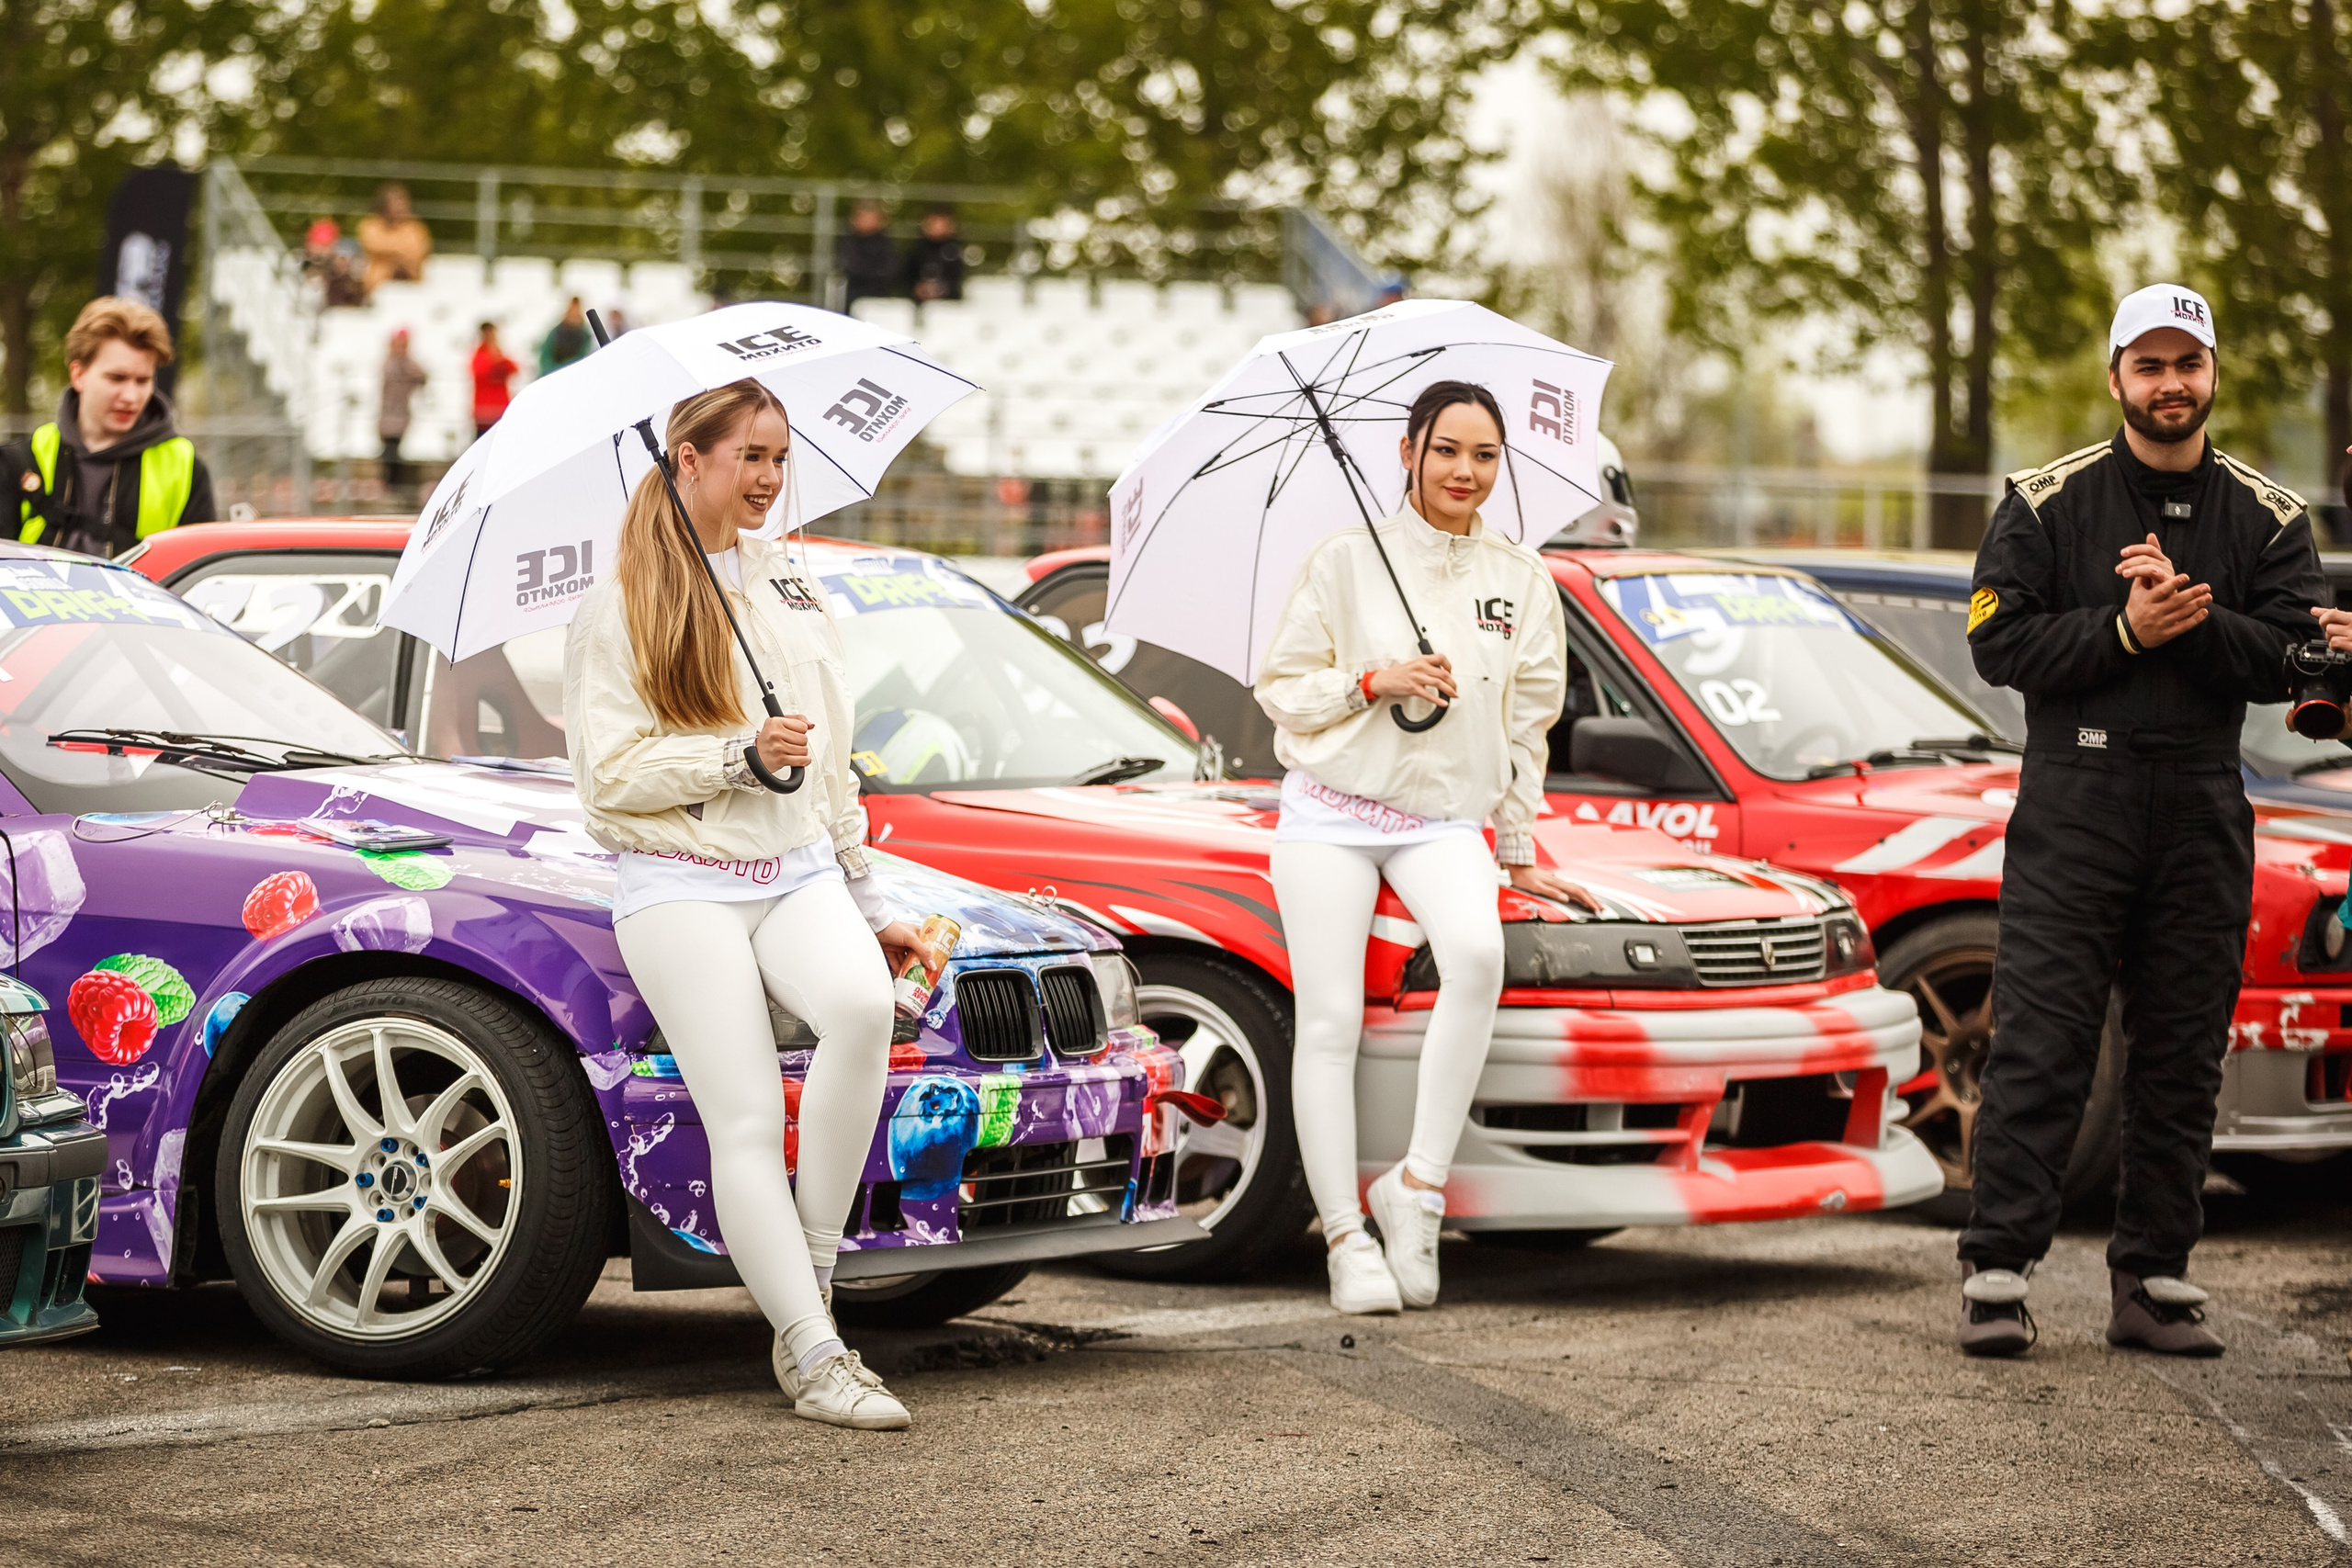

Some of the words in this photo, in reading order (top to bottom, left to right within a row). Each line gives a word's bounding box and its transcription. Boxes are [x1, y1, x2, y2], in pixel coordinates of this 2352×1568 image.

[2173, 296, 2204, 321] ICE
[717, 325, 813, 355] ICE
[739, 338, 823, 363] МОХИТО
[2029, 475, 2056, 492] OMP
[2266, 491, 2291, 512] OMP
[768, 577, 818, 604] ICE
[1475, 597, 1514, 629] ICE
[1699, 678, 1783, 727] 02
[2078, 731, 2108, 746] OMP
